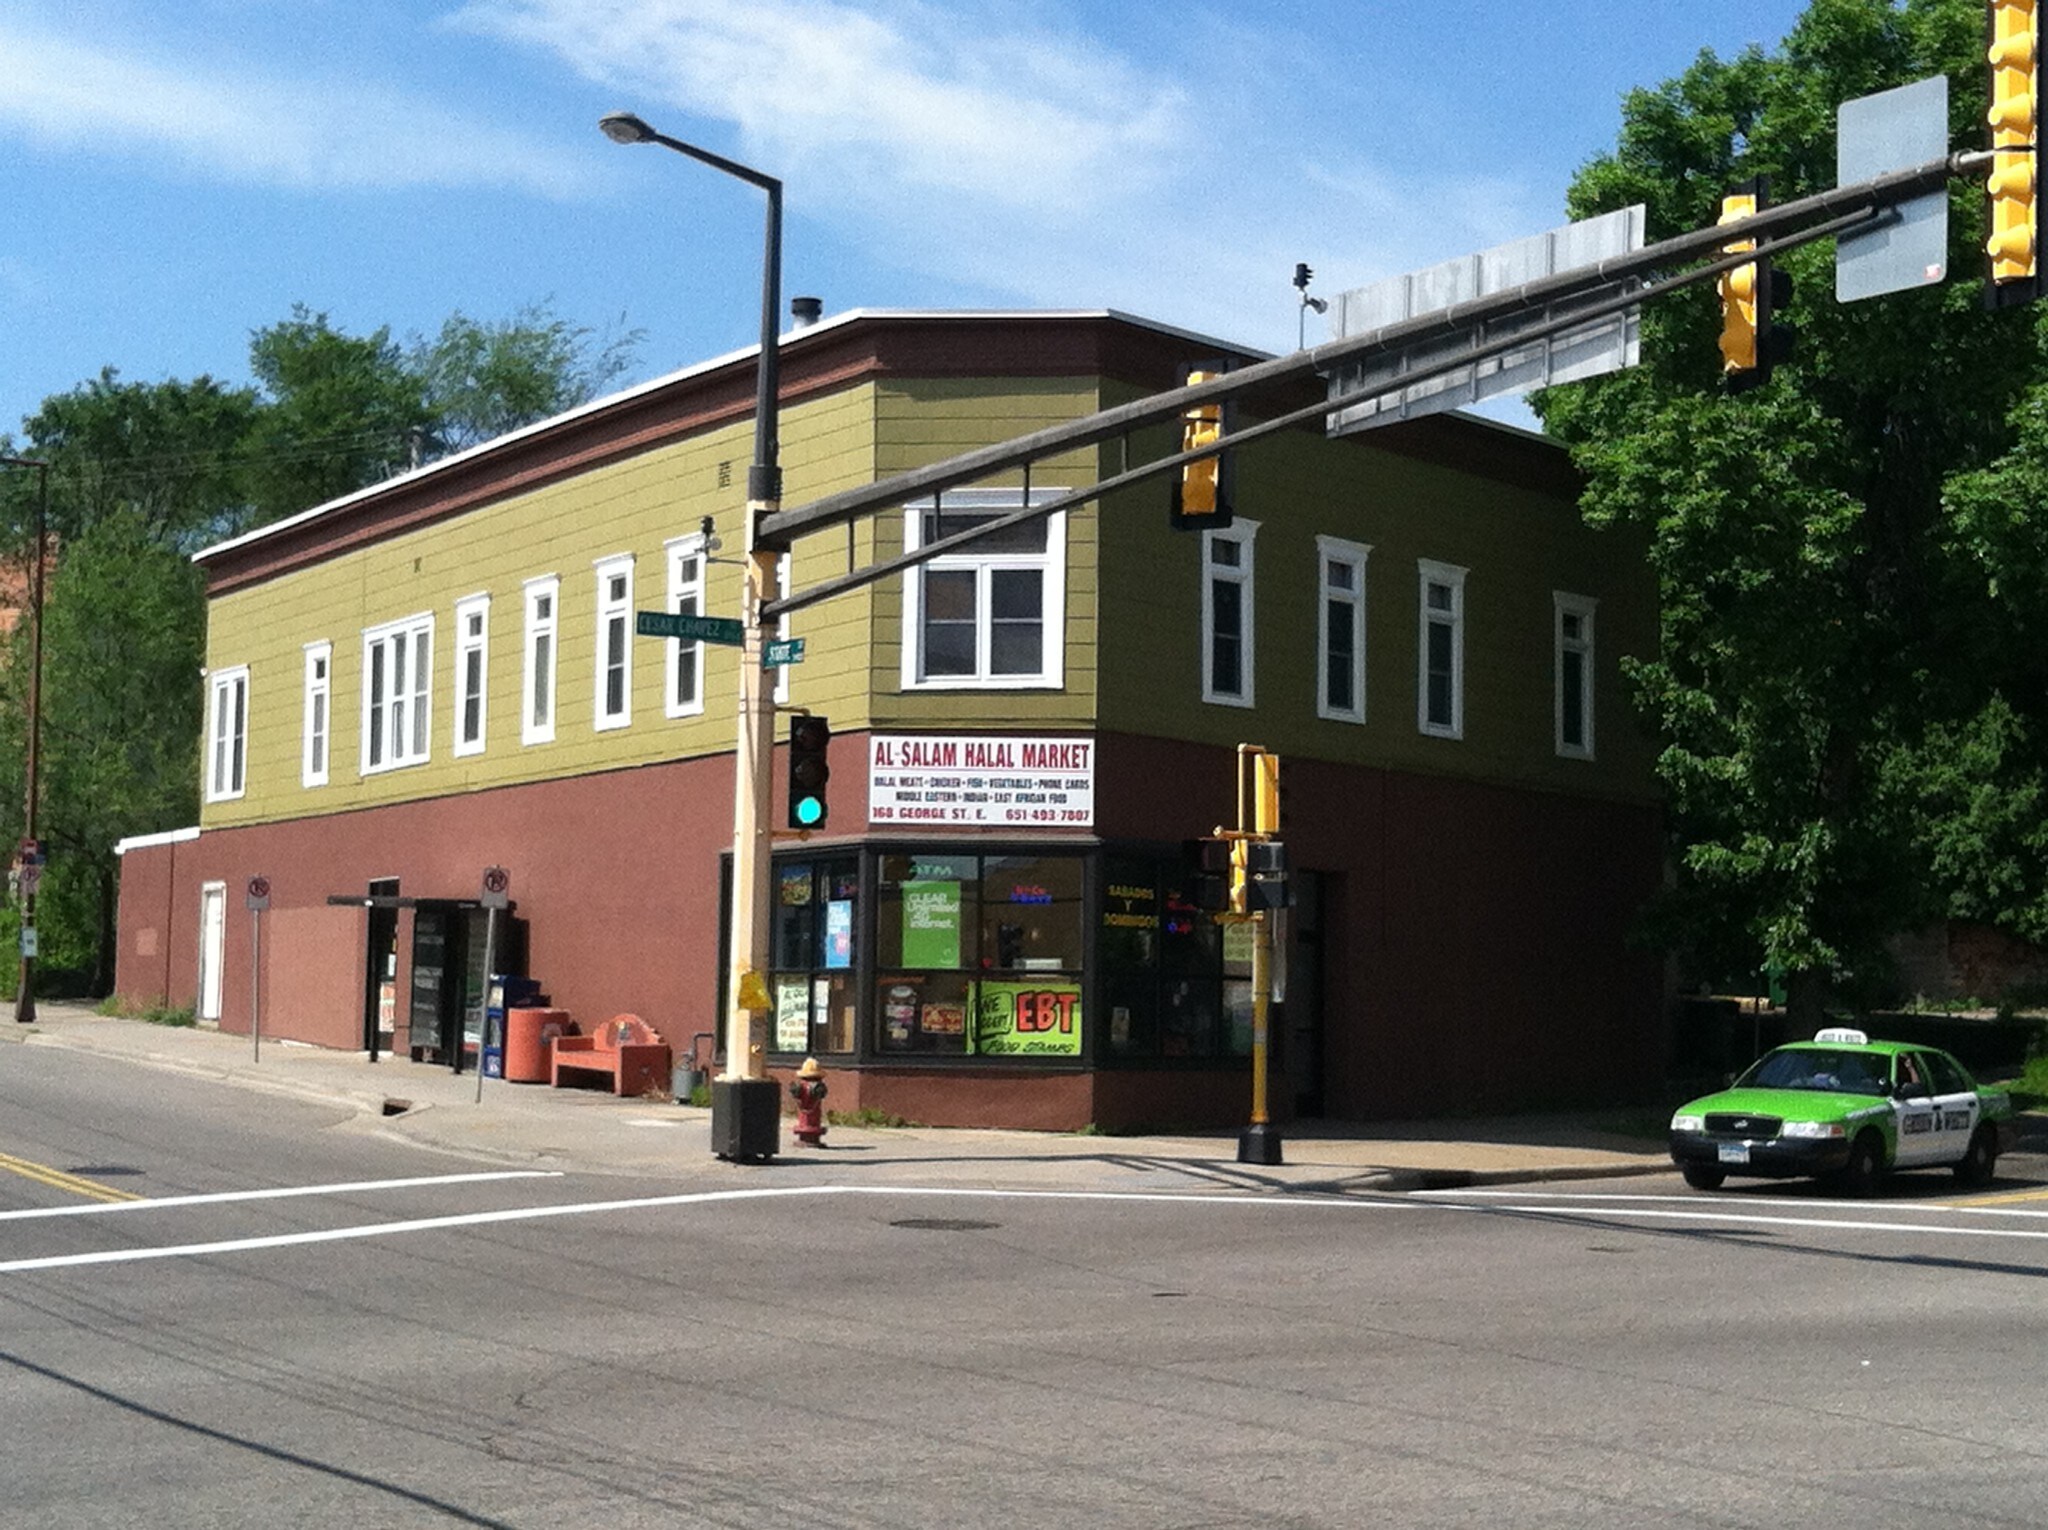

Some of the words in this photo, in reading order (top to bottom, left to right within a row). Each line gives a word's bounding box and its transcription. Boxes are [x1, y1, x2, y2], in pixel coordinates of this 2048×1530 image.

[679, 619, 720, 638] CHAVEZ
[875, 741, 957, 767] AL-SALAM
[965, 742, 1015, 768] HALAL
[1022, 743, 1090, 769] MARKET
[874, 776, 896, 787] HALAL
[900, 776, 923, 788] MEATS
[967, 777, 982, 789] FISH
[989, 778, 1033, 789] VEGETABLES
[1039, 778, 1062, 790] PHONE
[1065, 778, 1090, 790] CARDS
[925, 791, 957, 802] EASTERN
[994, 792, 1012, 804] EAST
[1015, 793, 1046, 804] AFRICAN
[1049, 793, 1067, 805] FOOD
[873, 806, 894, 819] 168
[899, 807, 946, 820] GEORGE
[1016, 989, 1081, 1034] EBT
